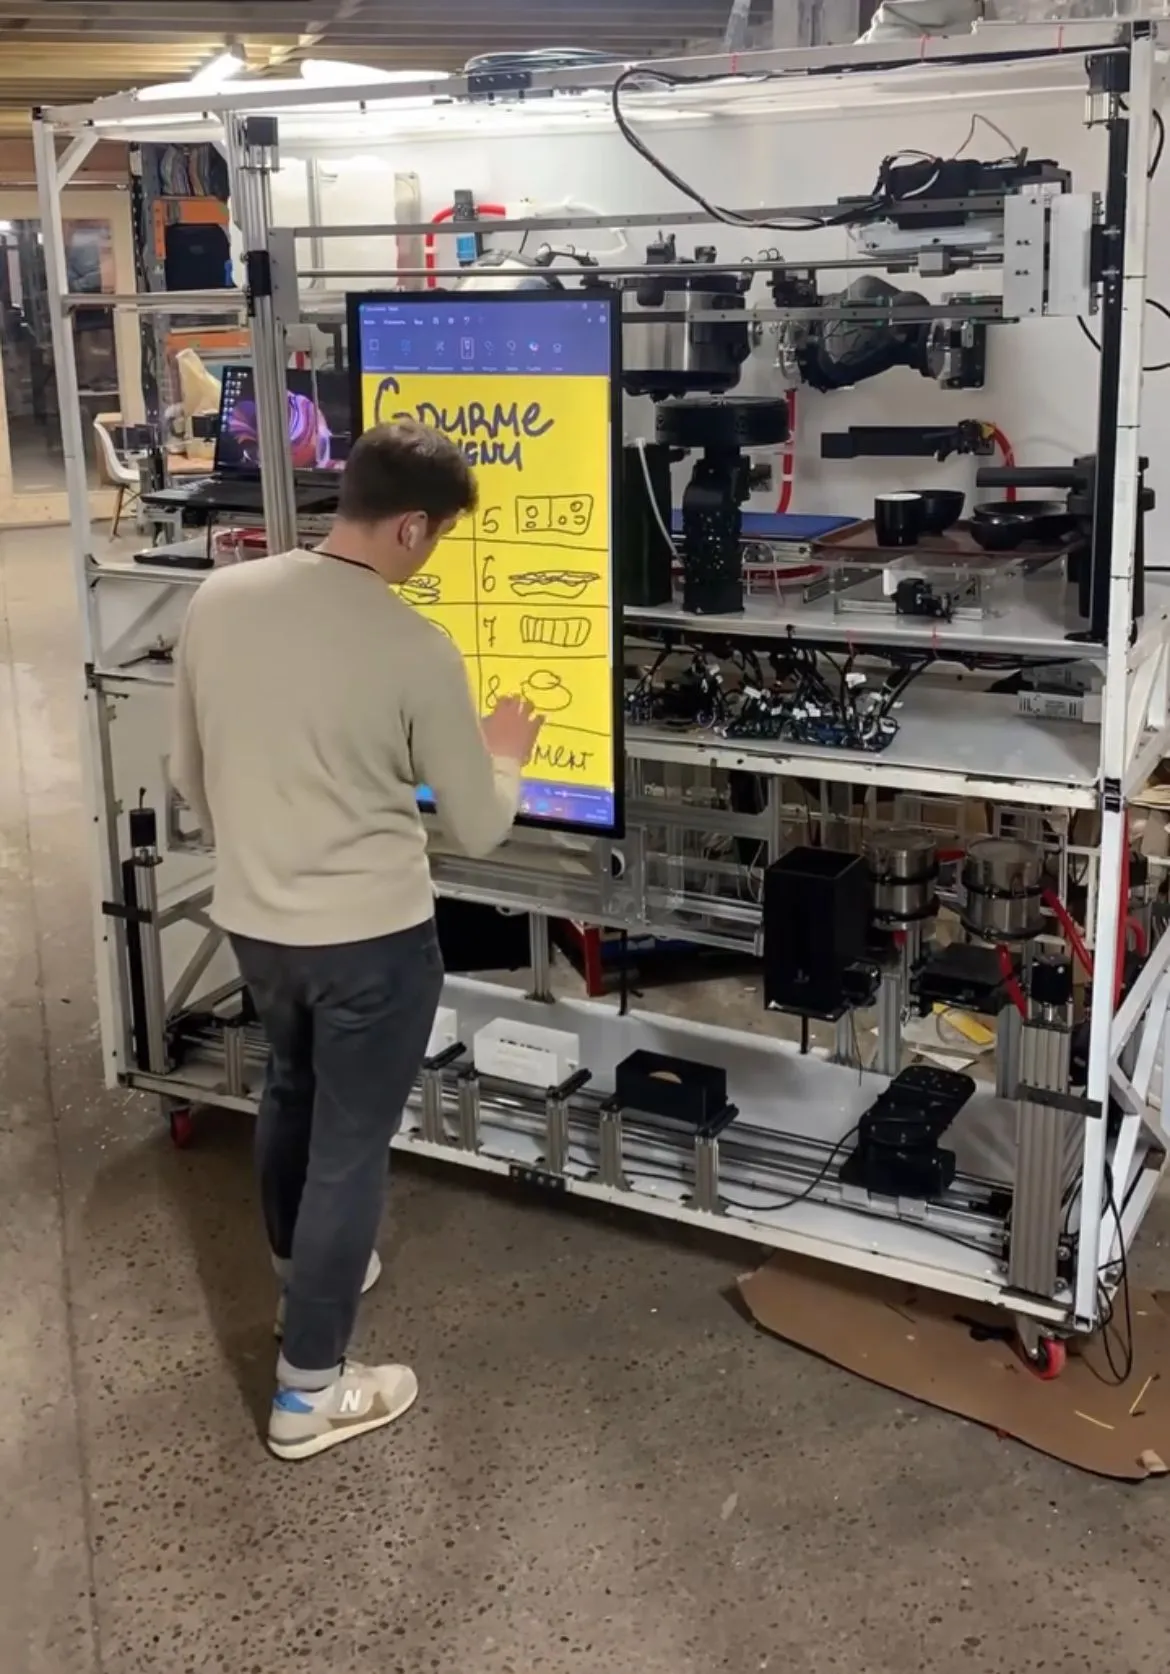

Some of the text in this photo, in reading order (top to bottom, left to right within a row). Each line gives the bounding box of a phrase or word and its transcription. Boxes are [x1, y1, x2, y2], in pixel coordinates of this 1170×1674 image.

[482, 506, 502, 533] 5
[482, 555, 496, 592] 6
[483, 616, 496, 648] 7
[485, 674, 500, 709] 8
[339, 1389, 362, 1413] N
